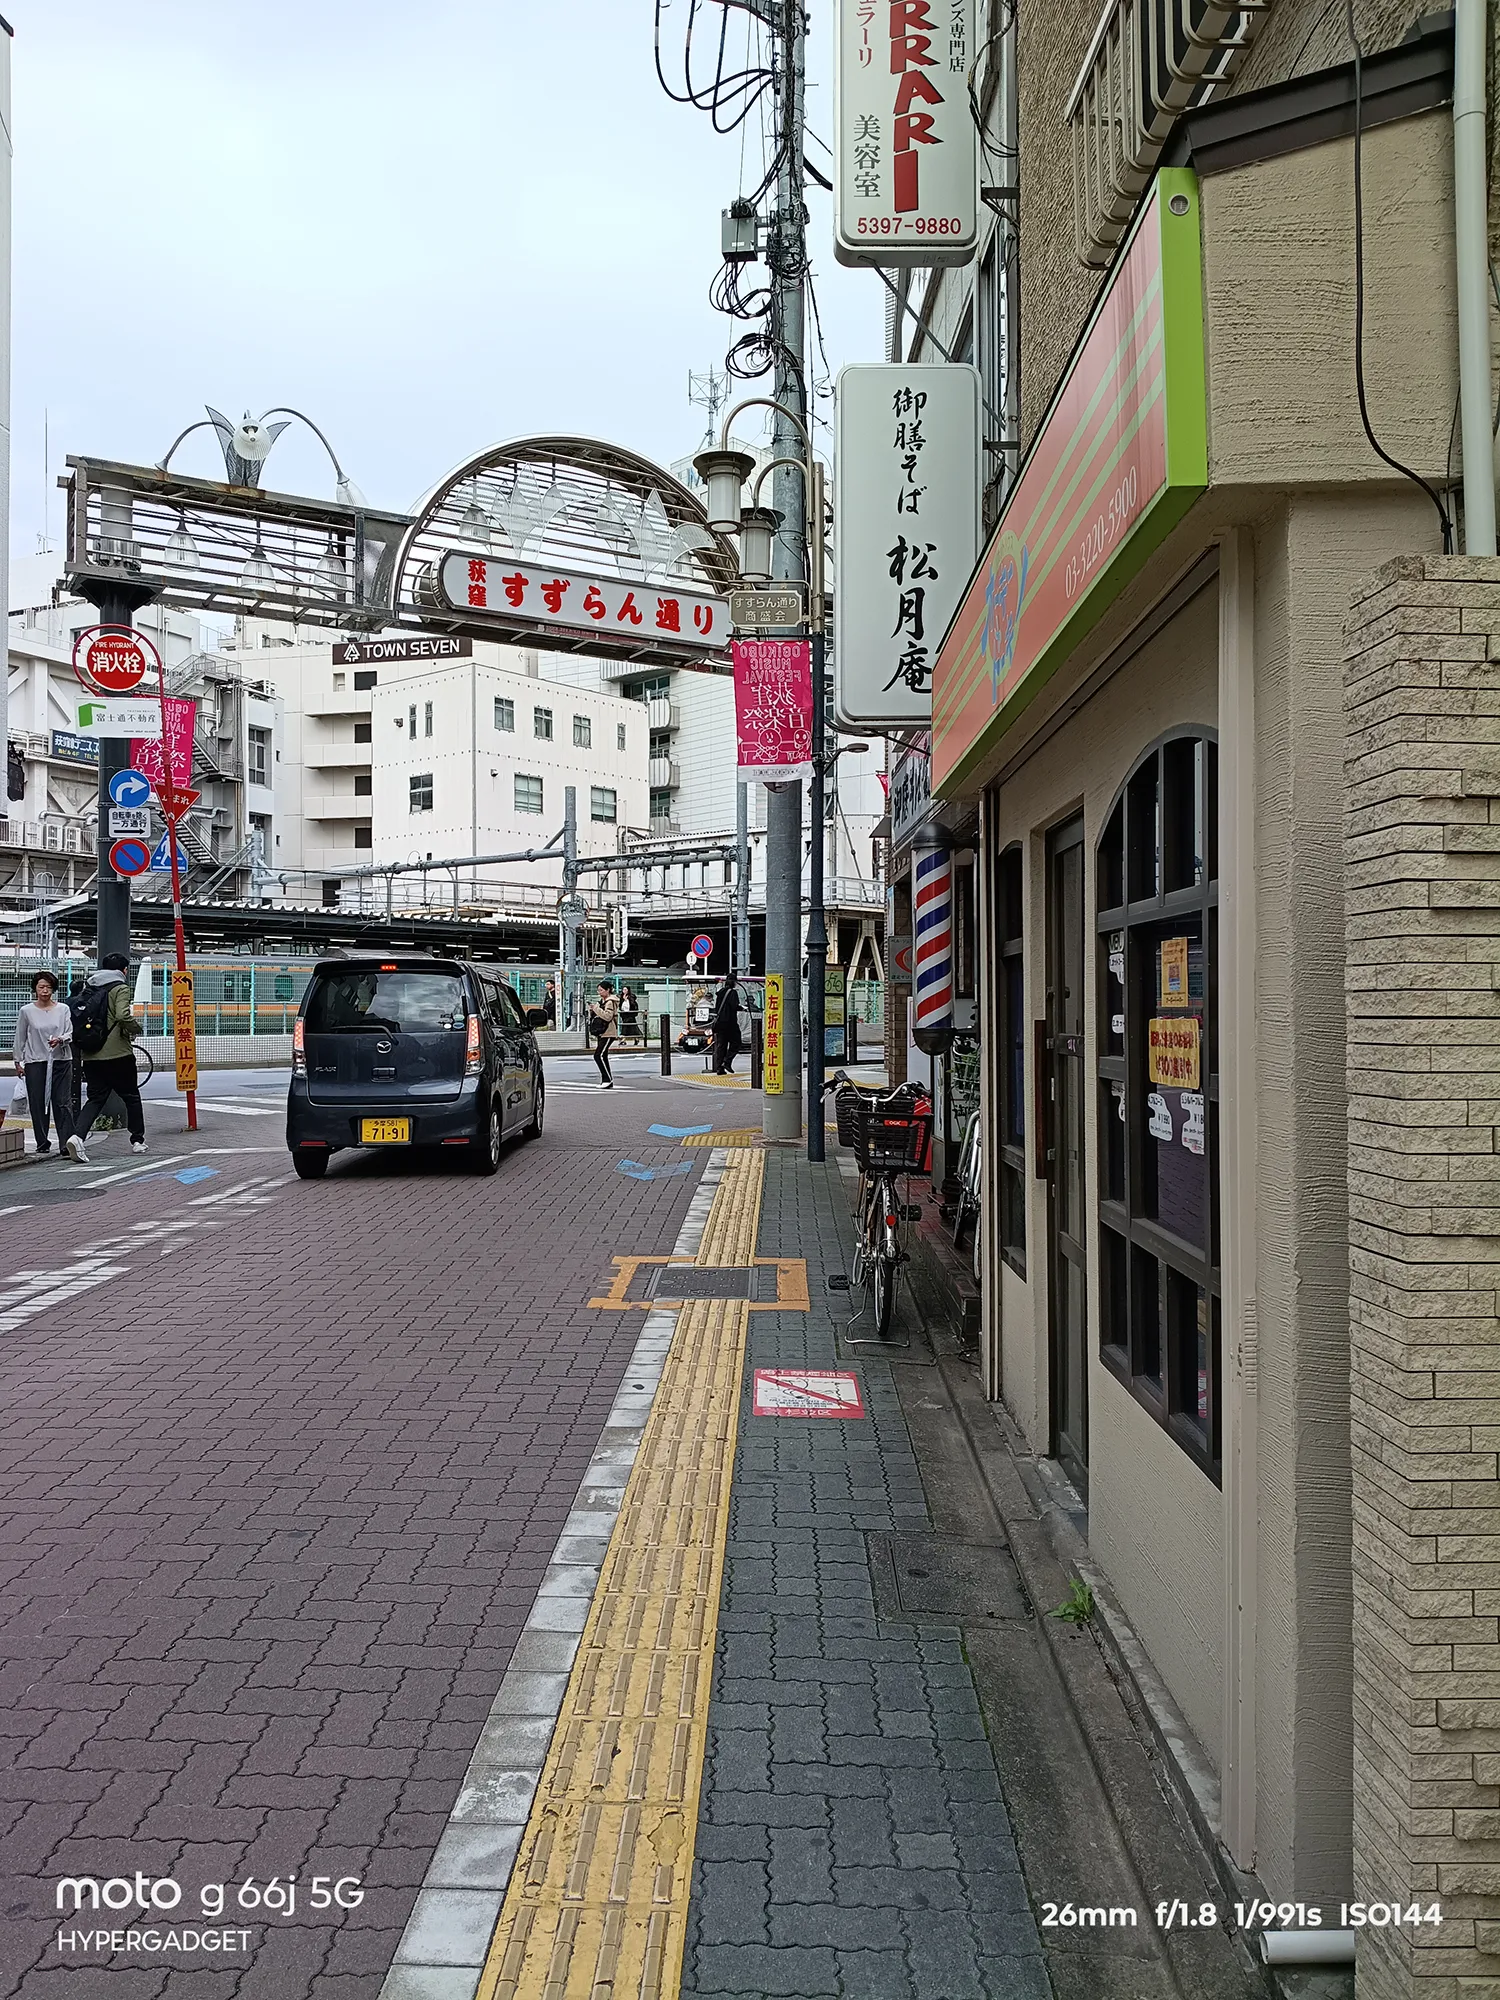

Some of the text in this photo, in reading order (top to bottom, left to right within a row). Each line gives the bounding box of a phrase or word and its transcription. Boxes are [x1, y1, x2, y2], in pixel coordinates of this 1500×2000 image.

[889, 0, 945, 213] RRARI
[853, 114, 881, 198] 美容室
[857, 217, 962, 235] 5397-9880
[892, 386, 929, 516] 御膳そば
[1064, 465, 1138, 599] 03-3220-5900
[467, 559, 488, 608] 荻窪
[501, 572, 714, 636] すずらん通り
[882, 534, 940, 695] 松月庵
[91, 651, 142, 673] 消火栓
[363, 639, 461, 659] TOWN SEVEN
[112, 811, 147, 820] 自転車を除く
[112, 820, 147, 828] 一方通行
[372, 1128, 404, 1140] 71-91
